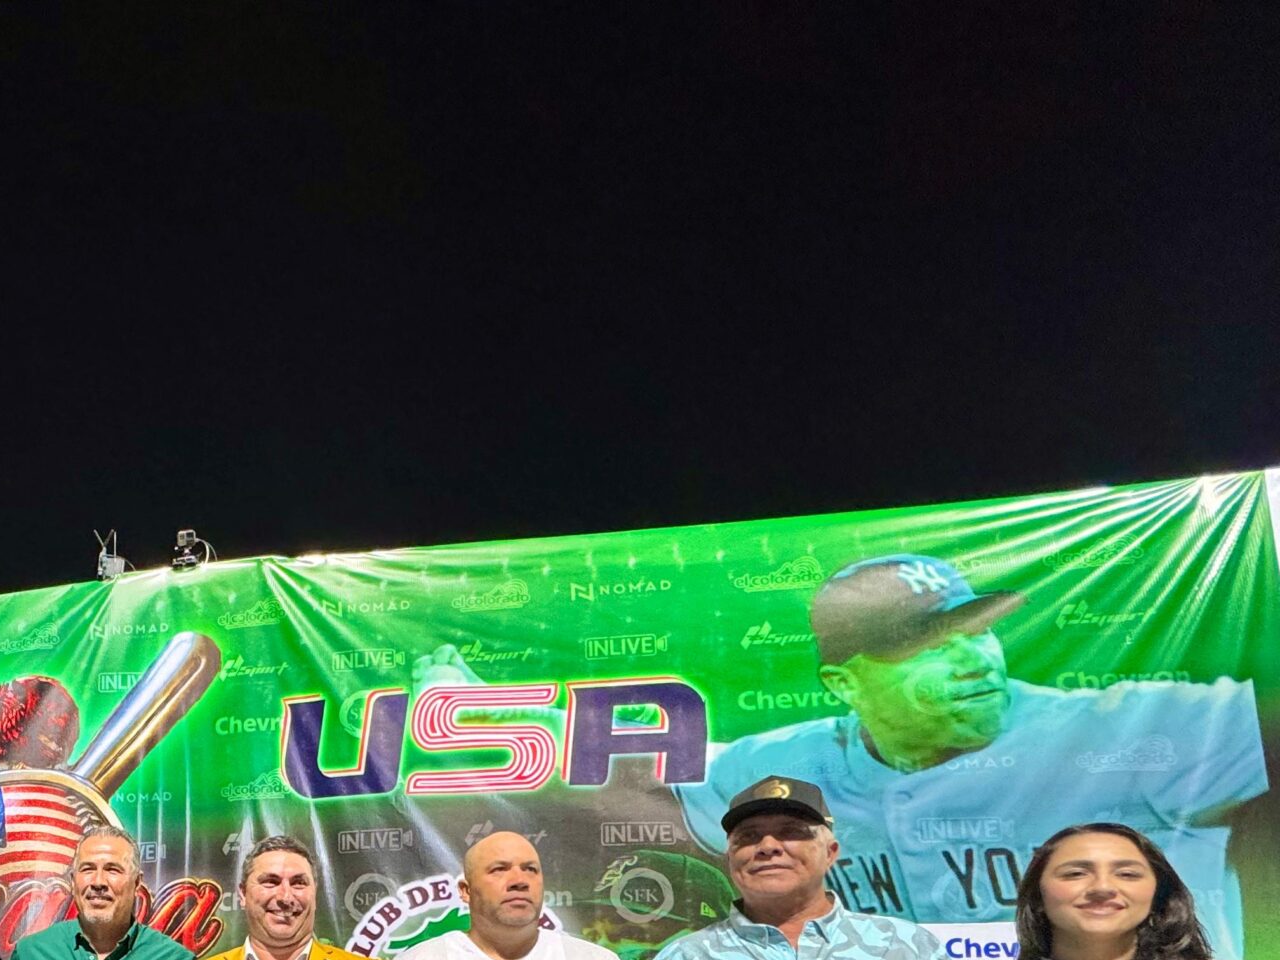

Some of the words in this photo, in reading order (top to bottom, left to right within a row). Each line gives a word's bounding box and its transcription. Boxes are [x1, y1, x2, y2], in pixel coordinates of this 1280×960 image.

[600, 580, 671, 595] NOMAD
[347, 601, 410, 612] NOMAD
[111, 623, 169, 635] NOMAD
[588, 636, 654, 657] INLIVE
[335, 651, 393, 670] INLIVE
[101, 675, 139, 690] INLIV
[738, 690, 841, 711] Chevro
[215, 716, 281, 736] Chevr
[281, 676, 708, 799] USA
[946, 756, 1015, 770] OMAD
[115, 791, 172, 802] NOMAD
[605, 824, 673, 843] INLIVE
[922, 819, 999, 840] INLIVE
[342, 830, 401, 851] INLIVE
[942, 848, 1021, 909] YO
[623, 889, 659, 903] SFK
[351, 902, 402, 959] LUB
[404, 879, 453, 910] DE
[946, 937, 1020, 958] Chev
